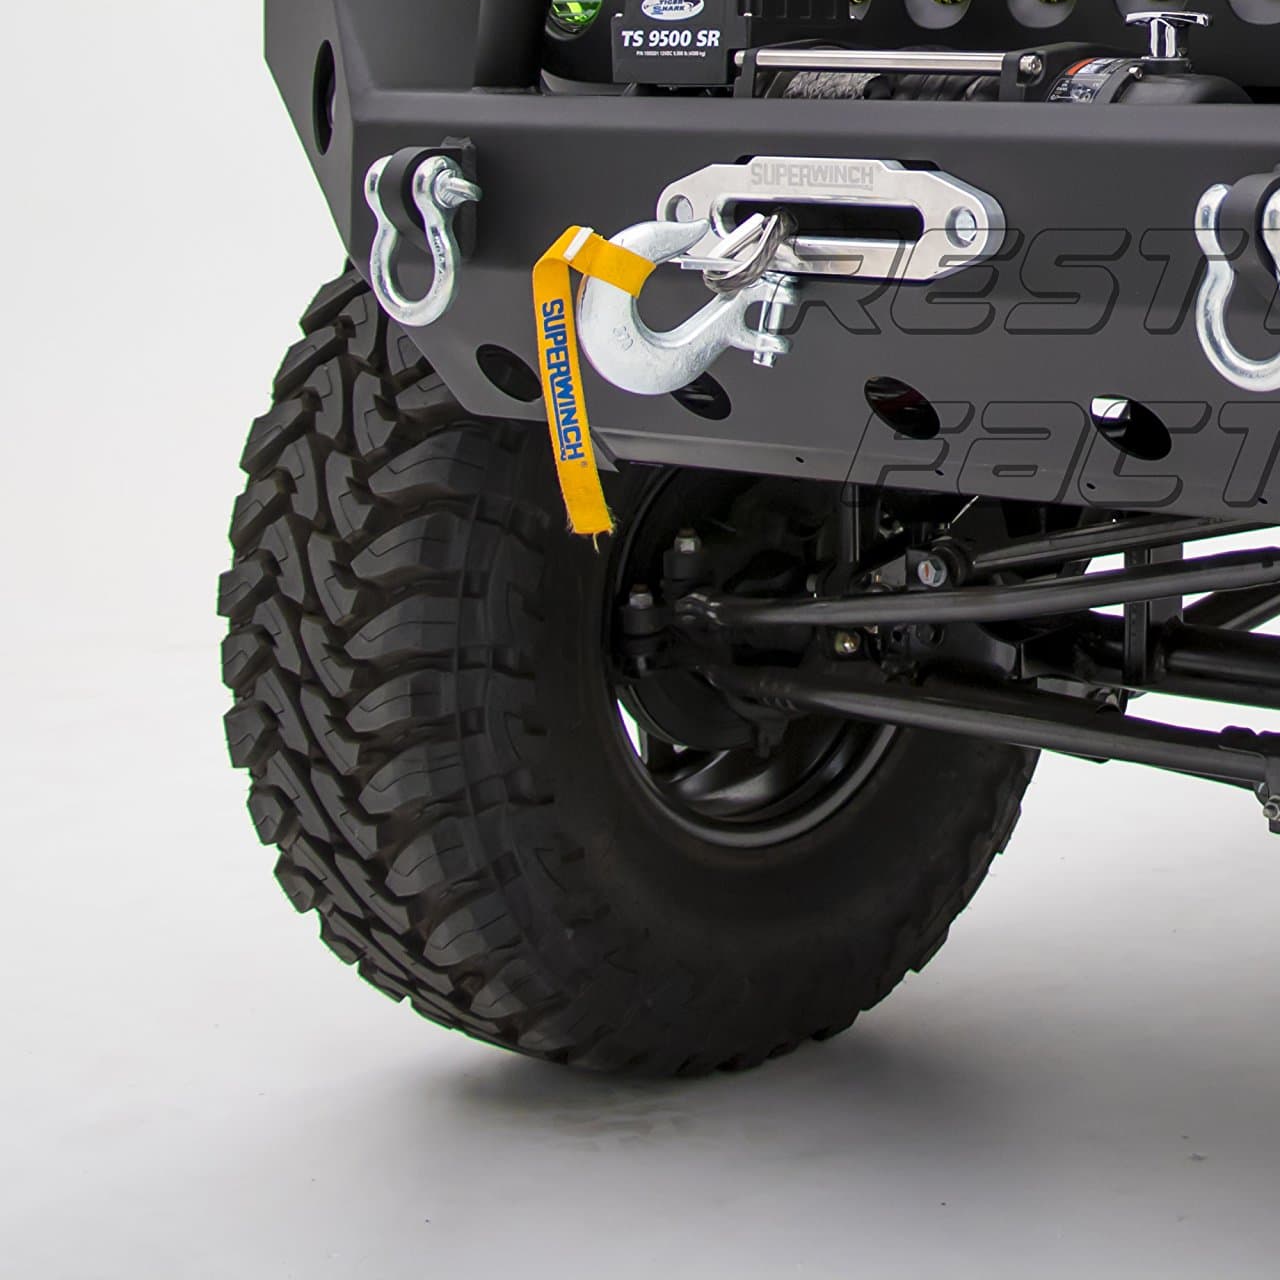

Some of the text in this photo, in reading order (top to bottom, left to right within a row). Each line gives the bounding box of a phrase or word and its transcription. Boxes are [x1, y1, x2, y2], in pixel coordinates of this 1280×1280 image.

[621, 30, 721, 47] TS 9500 SR
[751, 162, 875, 192] SUPERWINCH
[541, 298, 585, 461] SUPERWINCH
